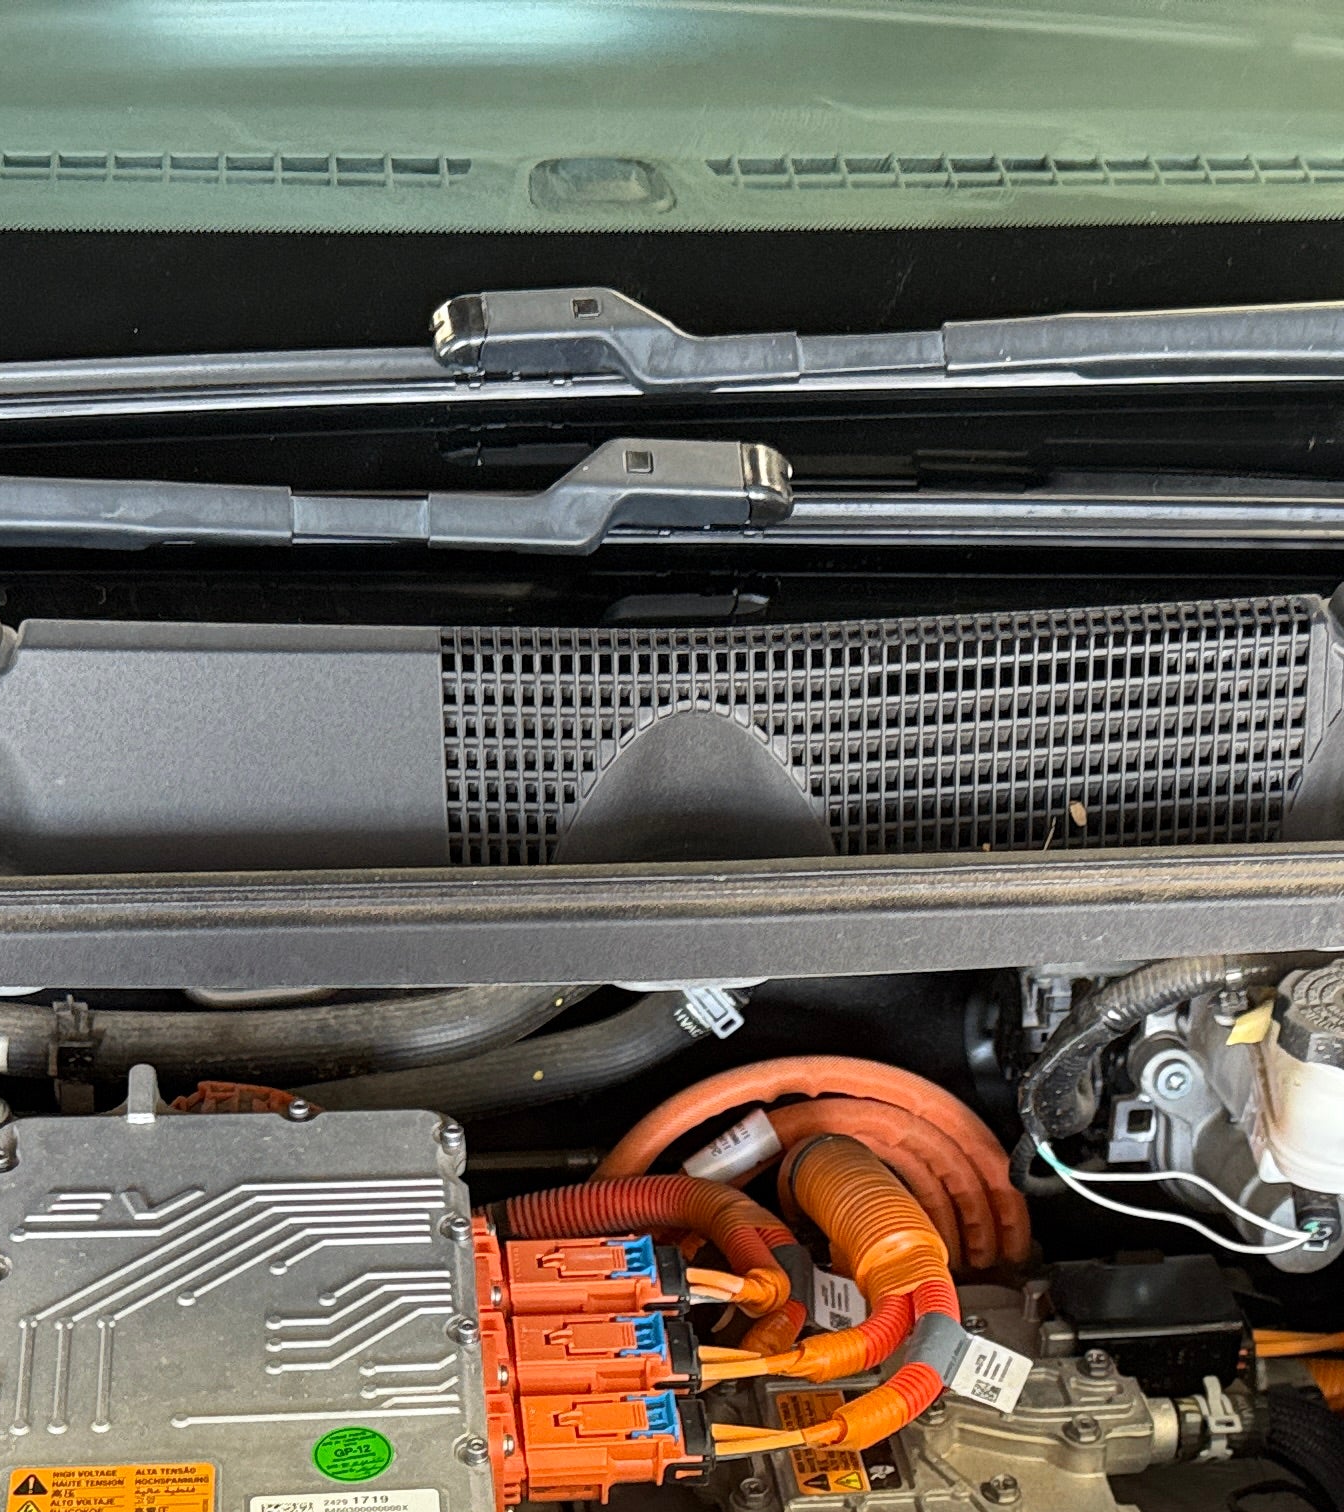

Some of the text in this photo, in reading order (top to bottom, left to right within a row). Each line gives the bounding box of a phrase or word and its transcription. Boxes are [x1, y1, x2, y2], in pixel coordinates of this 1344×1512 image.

[333, 1444, 372, 1457] GP-12
[78, 1469, 117, 1478] VOLTAGE
[135, 1467, 159, 1476] ALTA
[50, 1498, 73, 1506] ALTO
[353, 1495, 389, 1505] 1719
